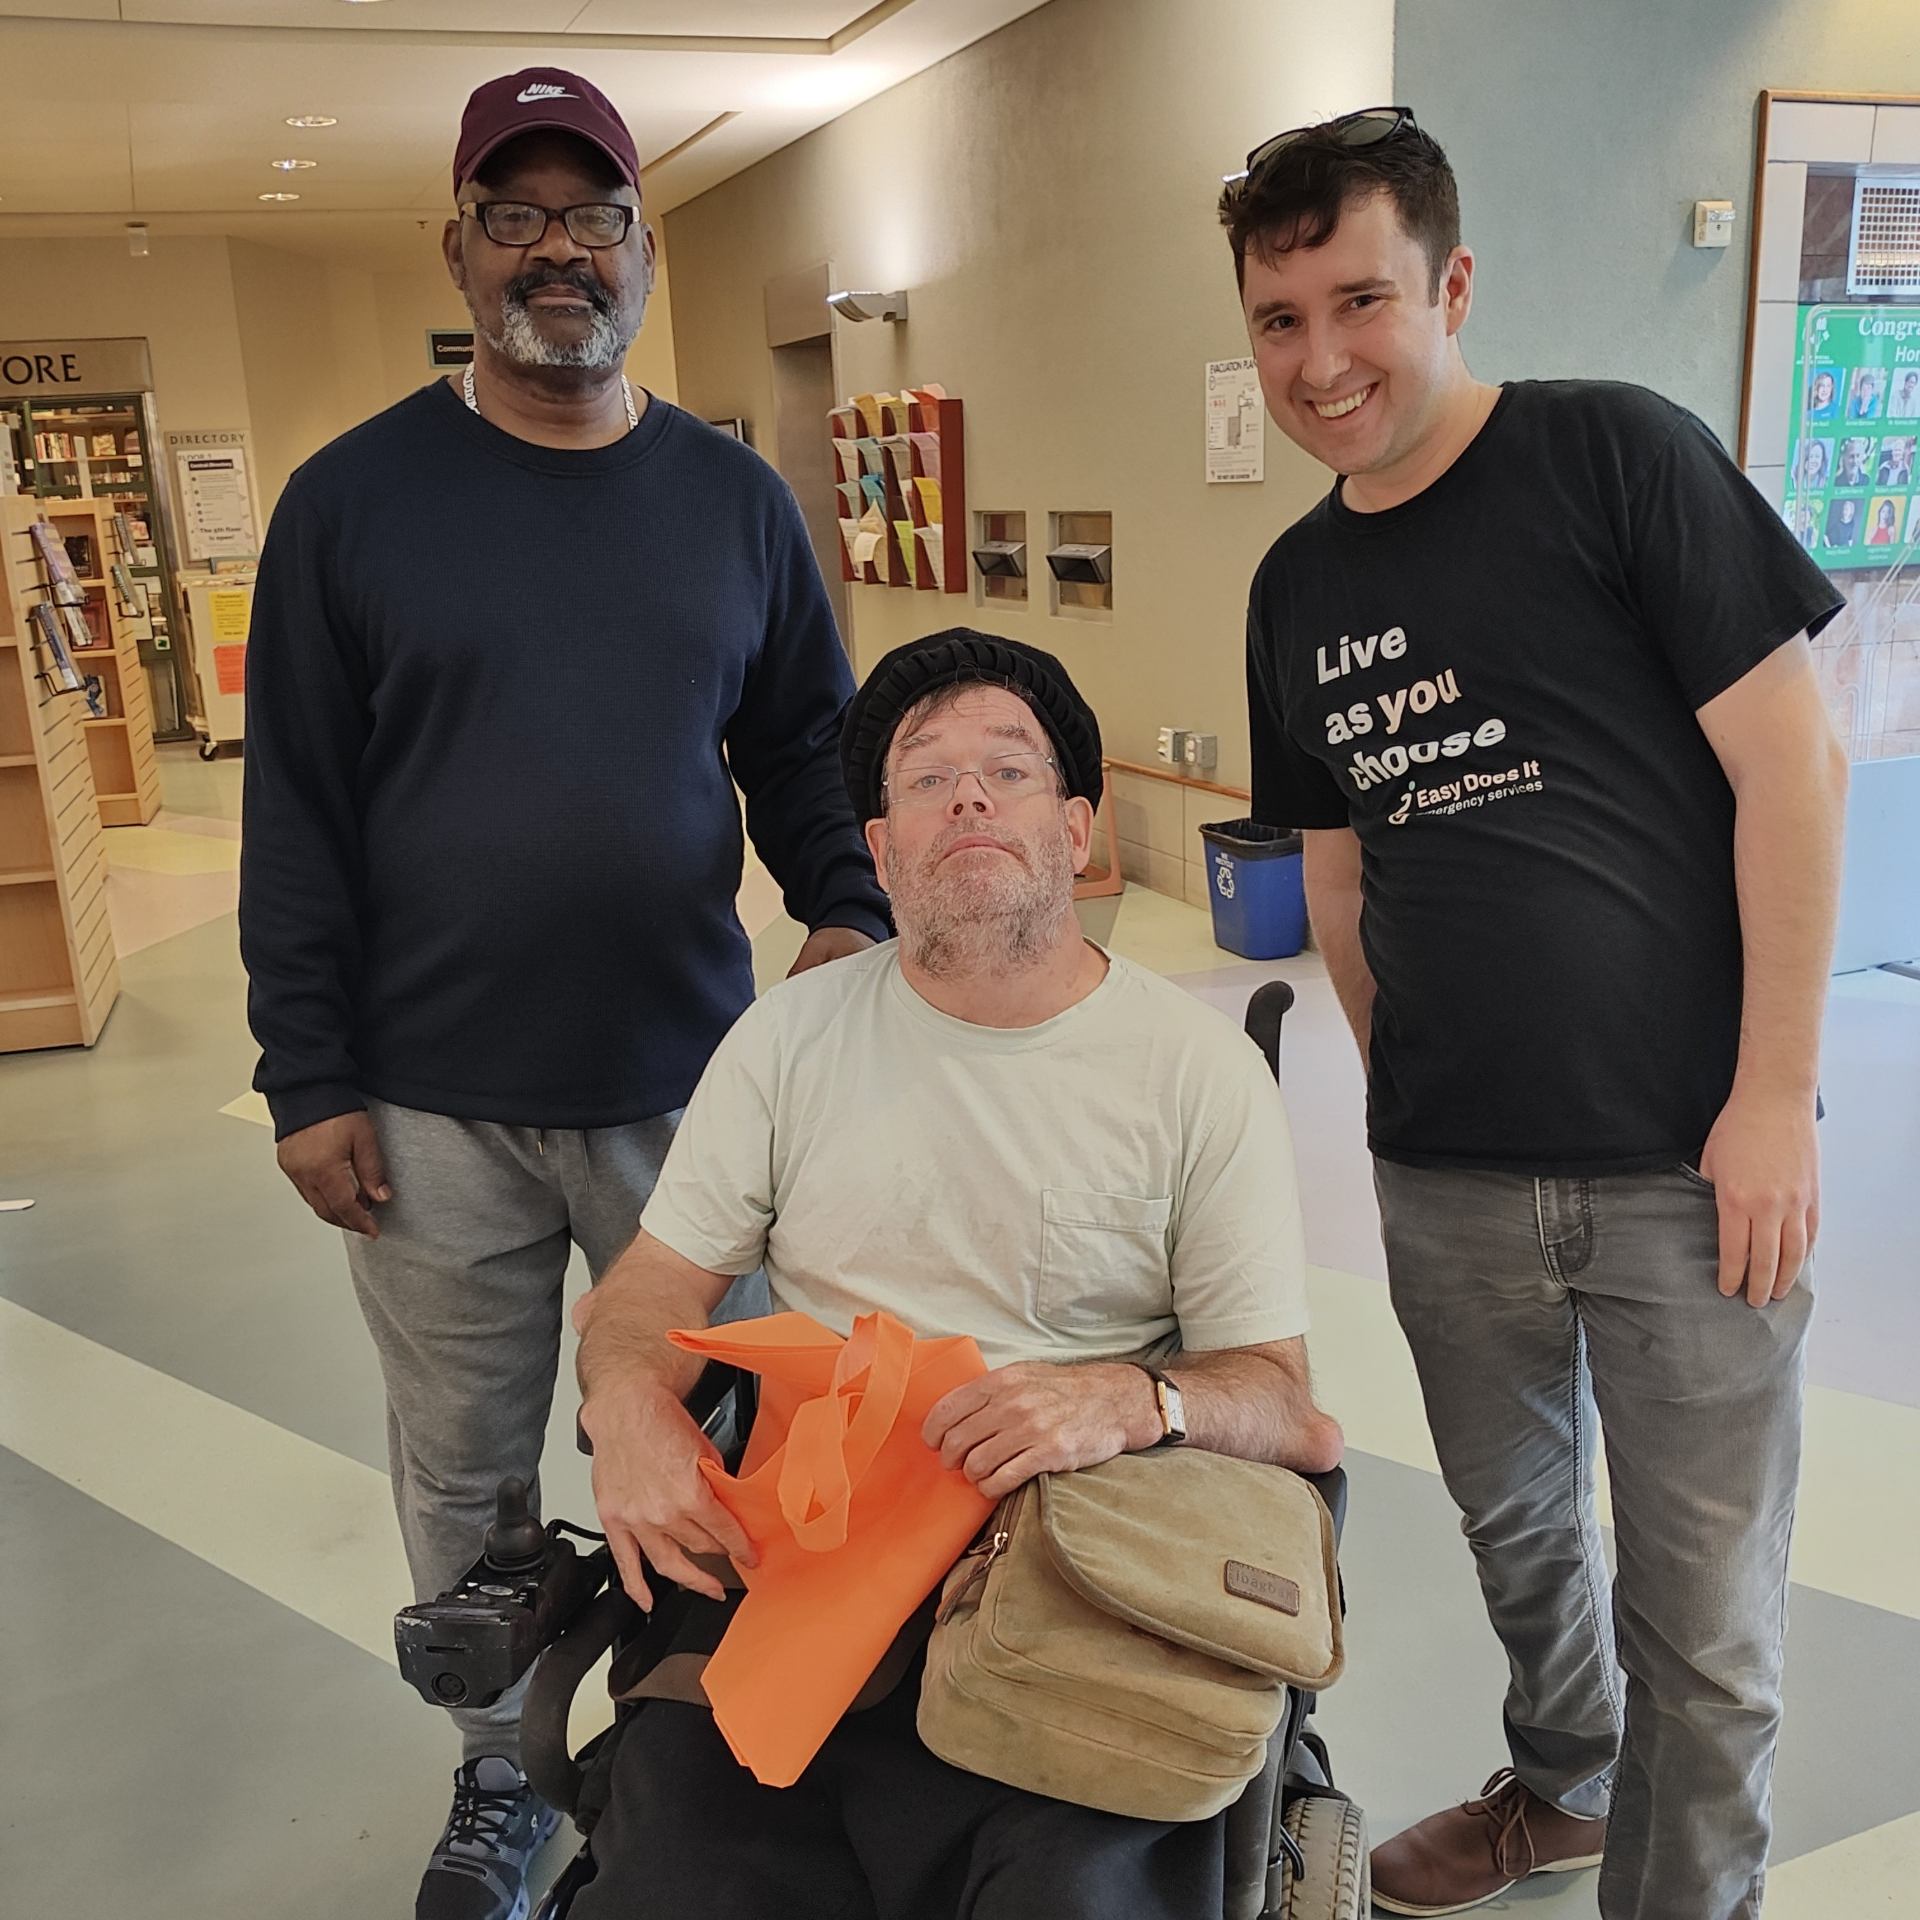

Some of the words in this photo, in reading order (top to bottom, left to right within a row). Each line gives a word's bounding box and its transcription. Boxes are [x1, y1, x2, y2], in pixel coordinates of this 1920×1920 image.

[526, 83, 566, 95] NIKE
[0, 354, 82, 385] ORE
[169, 433, 246, 445] DIRECTORY
[1316, 626, 1407, 685] Live
[1325, 702, 1373, 745] as
[1377, 668, 1463, 735] you
[1348, 718, 1507, 791] choose
[1416, 781, 1460, 809] Easy
[1463, 768, 1520, 792] Does
[1522, 760, 1541, 779] It
[1487, 780, 1544, 802] services
